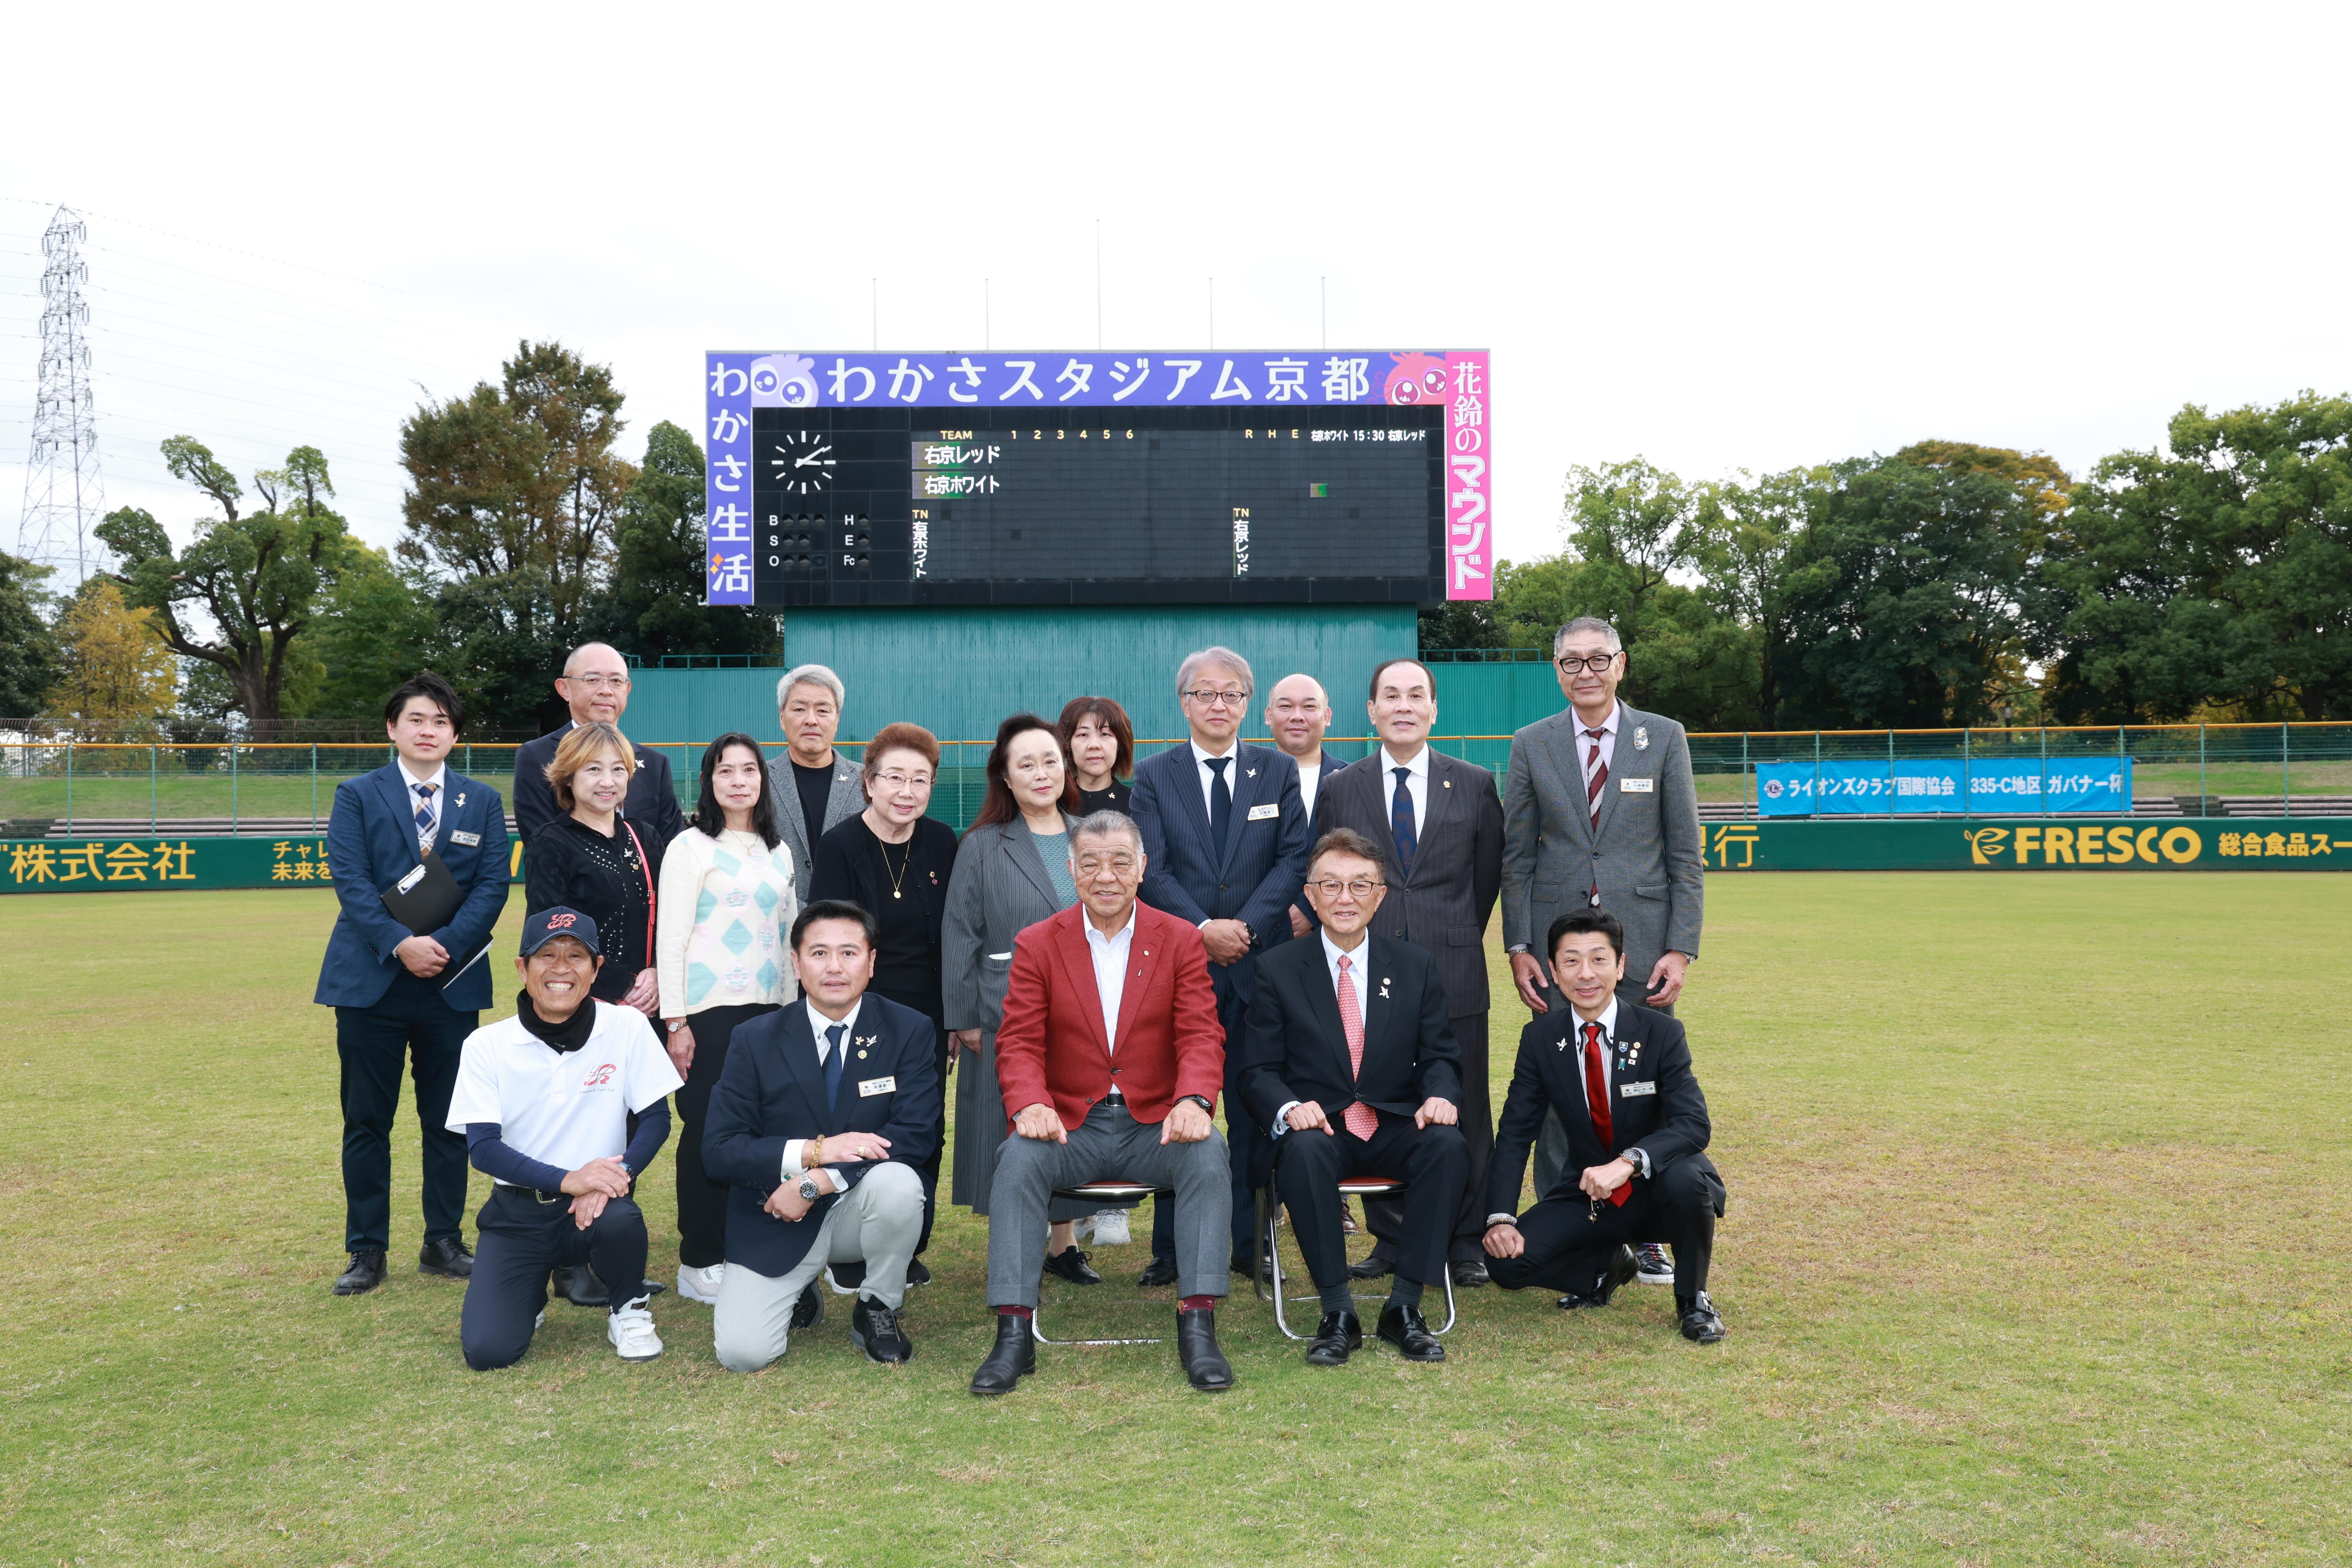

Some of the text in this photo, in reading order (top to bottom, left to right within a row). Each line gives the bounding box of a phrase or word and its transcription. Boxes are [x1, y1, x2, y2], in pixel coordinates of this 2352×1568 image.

[828, 356, 1369, 403] わかさスタジアム京都
[940, 429, 1133, 440] TEAM 1 2 3 4 5 6
[1245, 429, 1299, 439] R H E
[1311, 430, 1425, 442] 右京ホワイト 15:30 右京レッド
[924, 445, 1000, 465] 右京レッド
[710, 362, 751, 592] わかさ生活
[1451, 361, 1486, 589] 花鈴のマウンド
[924, 475, 1000, 494] 右京ホワイト
[769, 515, 779, 526] B
[845, 514, 854, 525] H
[912, 510, 928, 519] TN
[1233, 508, 1249, 517] TN
[769, 535, 779, 546] S
[845, 535, 854, 546] E
[913, 521, 928, 577] 右京ホワイト
[1234, 519, 1249, 575] 右京レッド
[769, 555, 779, 566] O
[1789, 774, 2122, 797] ライオンズクラブ国際協会 335-C地区 ガバナー杯
[274, 841, 328, 858] チャレ
[2014, 827, 2202, 863] FRESCO
[2219, 832, 2352, 856] 総合食品スー
[0, 842, 196, 883] 株式会社
[272, 862, 332, 880] 未来を
